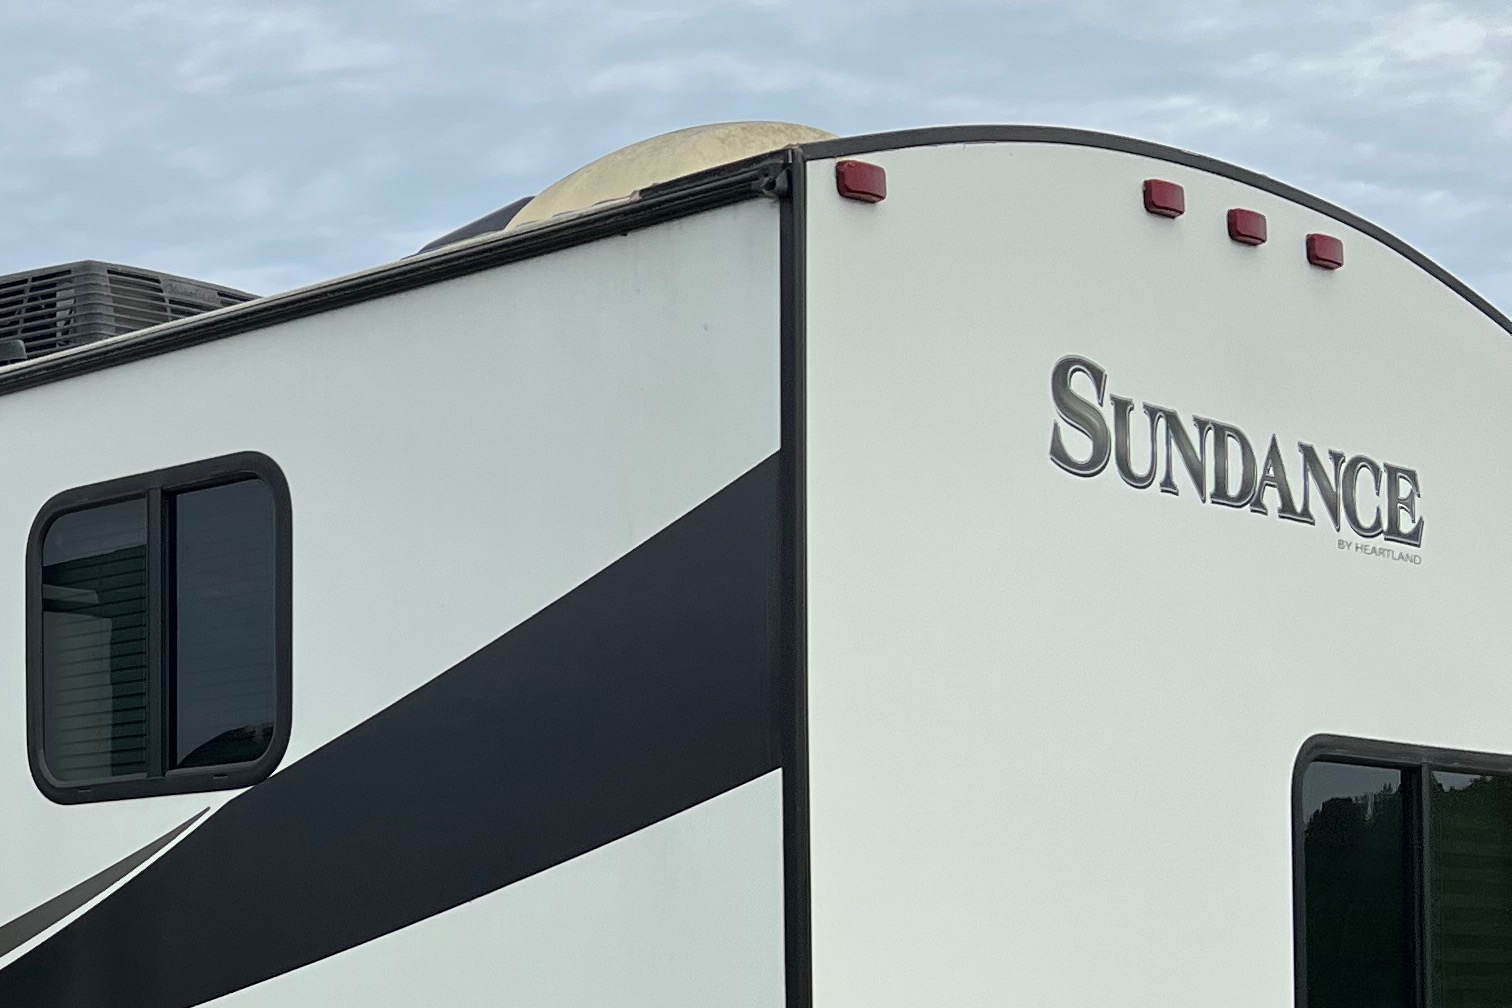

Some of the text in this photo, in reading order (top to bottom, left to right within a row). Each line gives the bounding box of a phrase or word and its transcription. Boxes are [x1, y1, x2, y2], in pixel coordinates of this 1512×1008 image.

[1049, 354, 1425, 548] SUNDANCE
[1337, 539, 1422, 565] BY HEARTLAND
